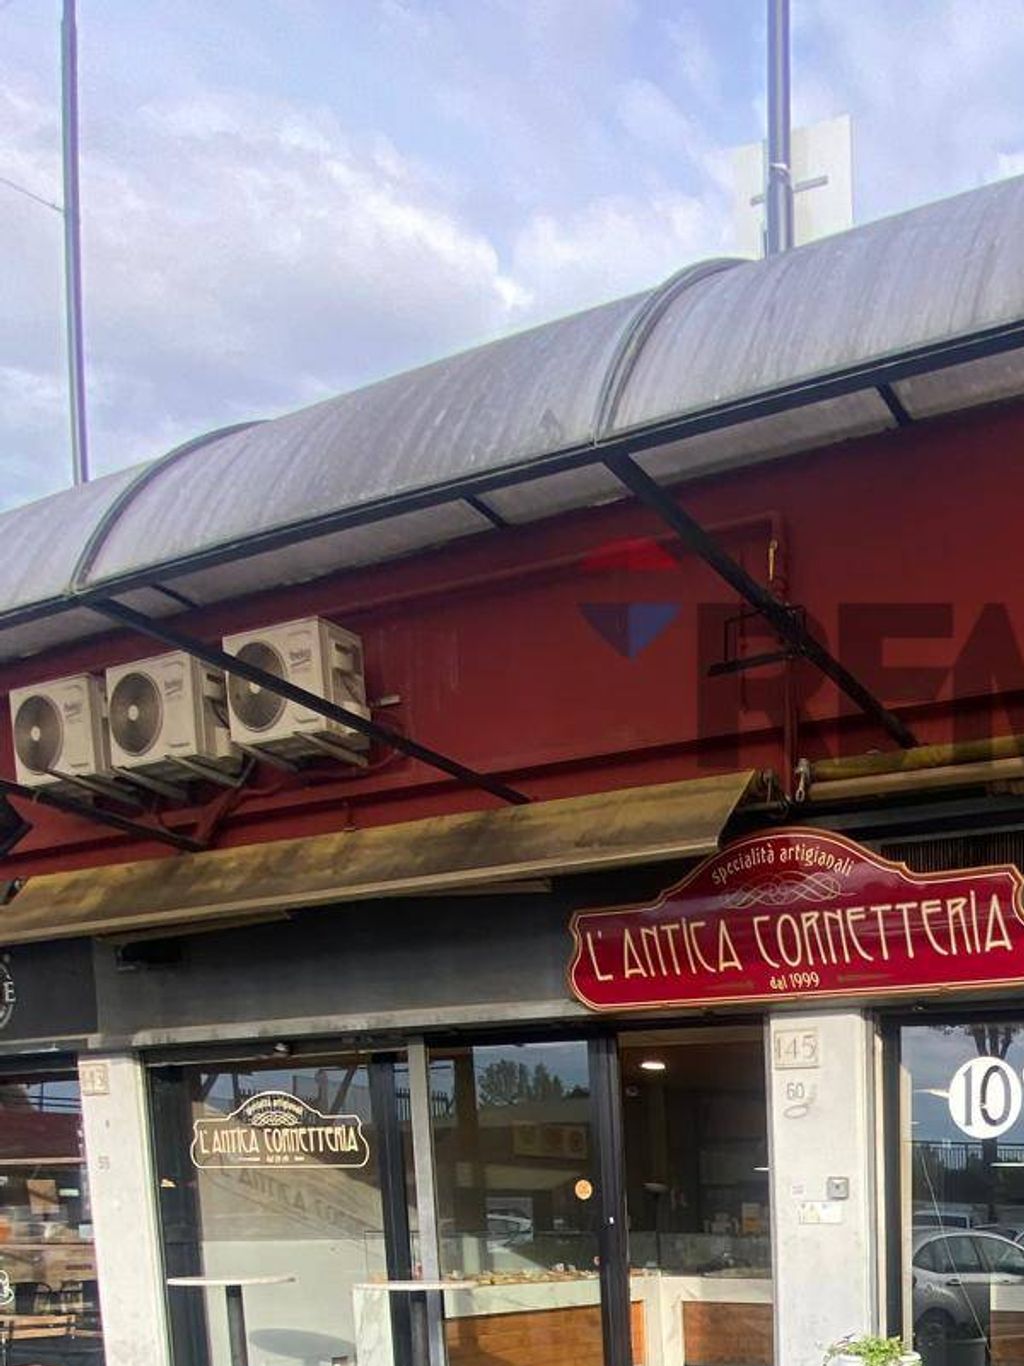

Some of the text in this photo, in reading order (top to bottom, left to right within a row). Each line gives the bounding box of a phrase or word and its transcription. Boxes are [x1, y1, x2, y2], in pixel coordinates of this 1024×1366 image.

[711, 841, 855, 885] specialità artigianali
[753, 889, 1013, 969] CORNETTERIA
[769, 971, 820, 991] dal 1999
[776, 1034, 818, 1060] 145
[962, 1064, 1013, 1128] 10
[264, 1123, 359, 1153] CORNETTERIA
